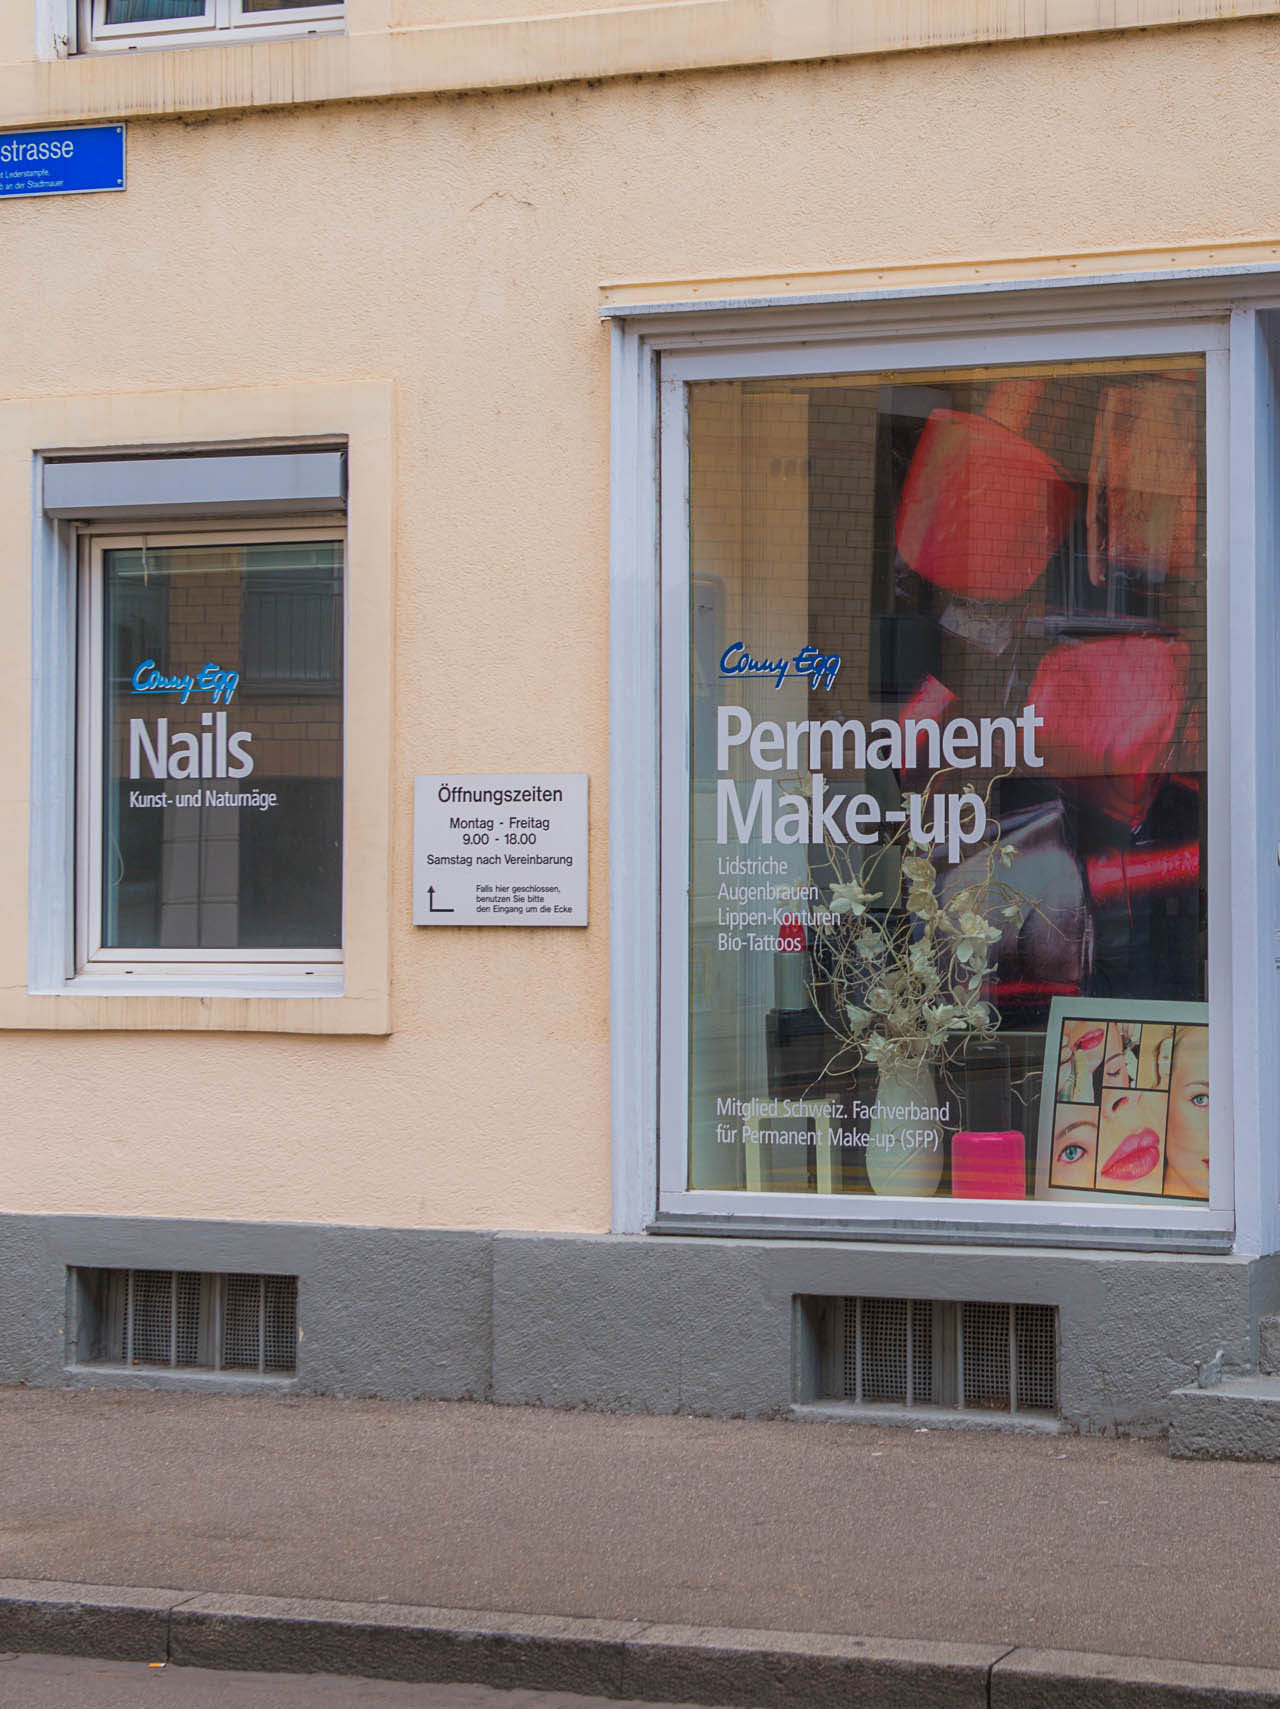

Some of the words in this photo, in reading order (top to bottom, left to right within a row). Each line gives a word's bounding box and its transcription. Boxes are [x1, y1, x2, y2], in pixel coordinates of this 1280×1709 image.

[719, 641, 792, 690] Conny
[793, 644, 841, 691] Egg
[130, 658, 195, 704] Conny
[196, 662, 239, 705] Egg
[129, 712, 254, 779] Nails
[717, 704, 1045, 771] Permanent
[129, 791, 173, 808] Kunst-
[176, 789, 202, 807] und
[438, 783, 563, 805] Öffnungszeiten
[449, 817, 494, 831] Montag
[509, 817, 550, 831] Freitag
[716, 774, 987, 864] Make-up
[462, 833, 489, 846] 9.00
[504, 833, 537, 845] 18.00
[427, 854, 472, 867] Samstag
[476, 855, 501, 865] nach
[504, 854, 573, 867] Vereinbarung
[718, 856, 788, 876] Lidstriche
[476, 885, 493, 893] Falls
[495, 885, 509, 893] hier
[512, 885, 561, 895] geschlossen,
[476, 895, 511, 903] benutzen
[513, 895, 526, 903] Sie
[527, 895, 545, 903] bitte
[717, 883, 819, 905] Augenbrauen
[476, 905, 491, 913] den
[493, 905, 524, 915] Eingang
[539, 905, 552, 913] die
[554, 905, 573, 913] Ecke
[718, 909, 841, 933] Lippen-Konturen
[718, 934, 801, 951] Bio-Tattoos
[716, 1098, 778, 1121] Mitglied
[782, 1098, 848, 1119] Schweiz.
[853, 1100, 950, 1122] Fachverband
[716, 1123, 738, 1144] für
[742, 1126, 823, 1146] Permanent
[827, 1127, 895, 1151] Make-up
[900, 1129, 939, 1152] (SFP)
